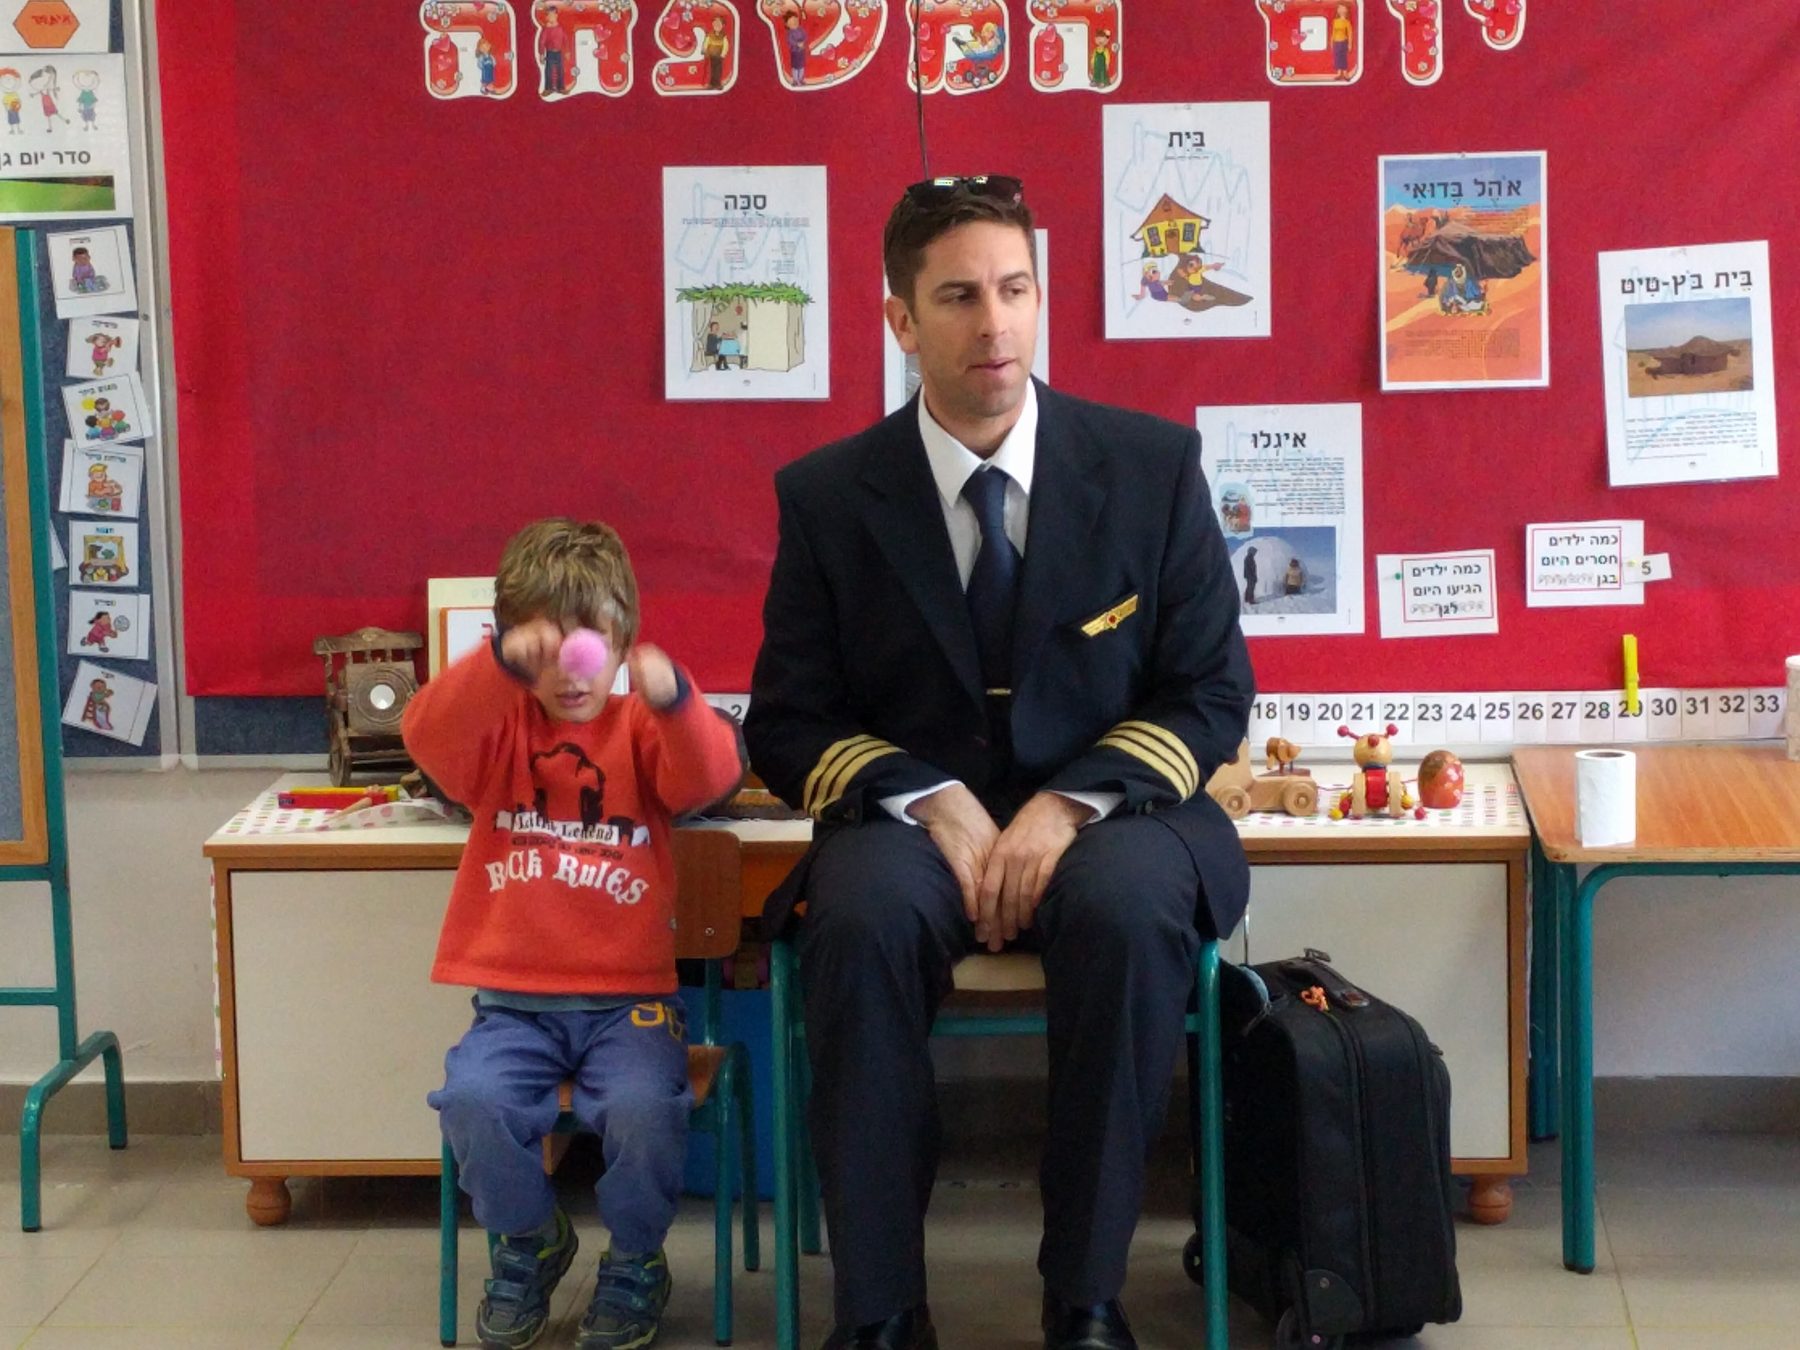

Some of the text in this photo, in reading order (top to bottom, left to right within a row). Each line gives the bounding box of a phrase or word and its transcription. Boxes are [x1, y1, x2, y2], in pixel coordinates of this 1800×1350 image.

[0, 150, 91, 170] סדר יום ג
[1549, 535, 1619, 547] כמה ילדים
[1541, 555, 1618, 567] חסרים היום
[1641, 561, 1652, 575] 5
[1412, 564, 1482, 578] כמה ילדים
[1596, 573, 1619, 588] בגן
[1413, 583, 1482, 597] הגיעו היום
[1253, 702, 1278, 720] 18
[1286, 703, 1311, 721] 19
[1317, 703, 1343, 721] 20
[1350, 703, 1375, 721] 21
[1383, 703, 1410, 721] 22
[1417, 703, 1443, 721] 23
[1450, 703, 1477, 721] 24
[1484, 702, 1511, 720] 25
[1517, 702, 1544, 720] 26
[1551, 702, 1577, 720] 27
[1584, 702, 1611, 719] 28
[1651, 697, 1677, 716] 30
[1686, 696, 1710, 715] 31
[1718, 695, 1744, 714] 32
[1753, 694, 1780, 713] 33
